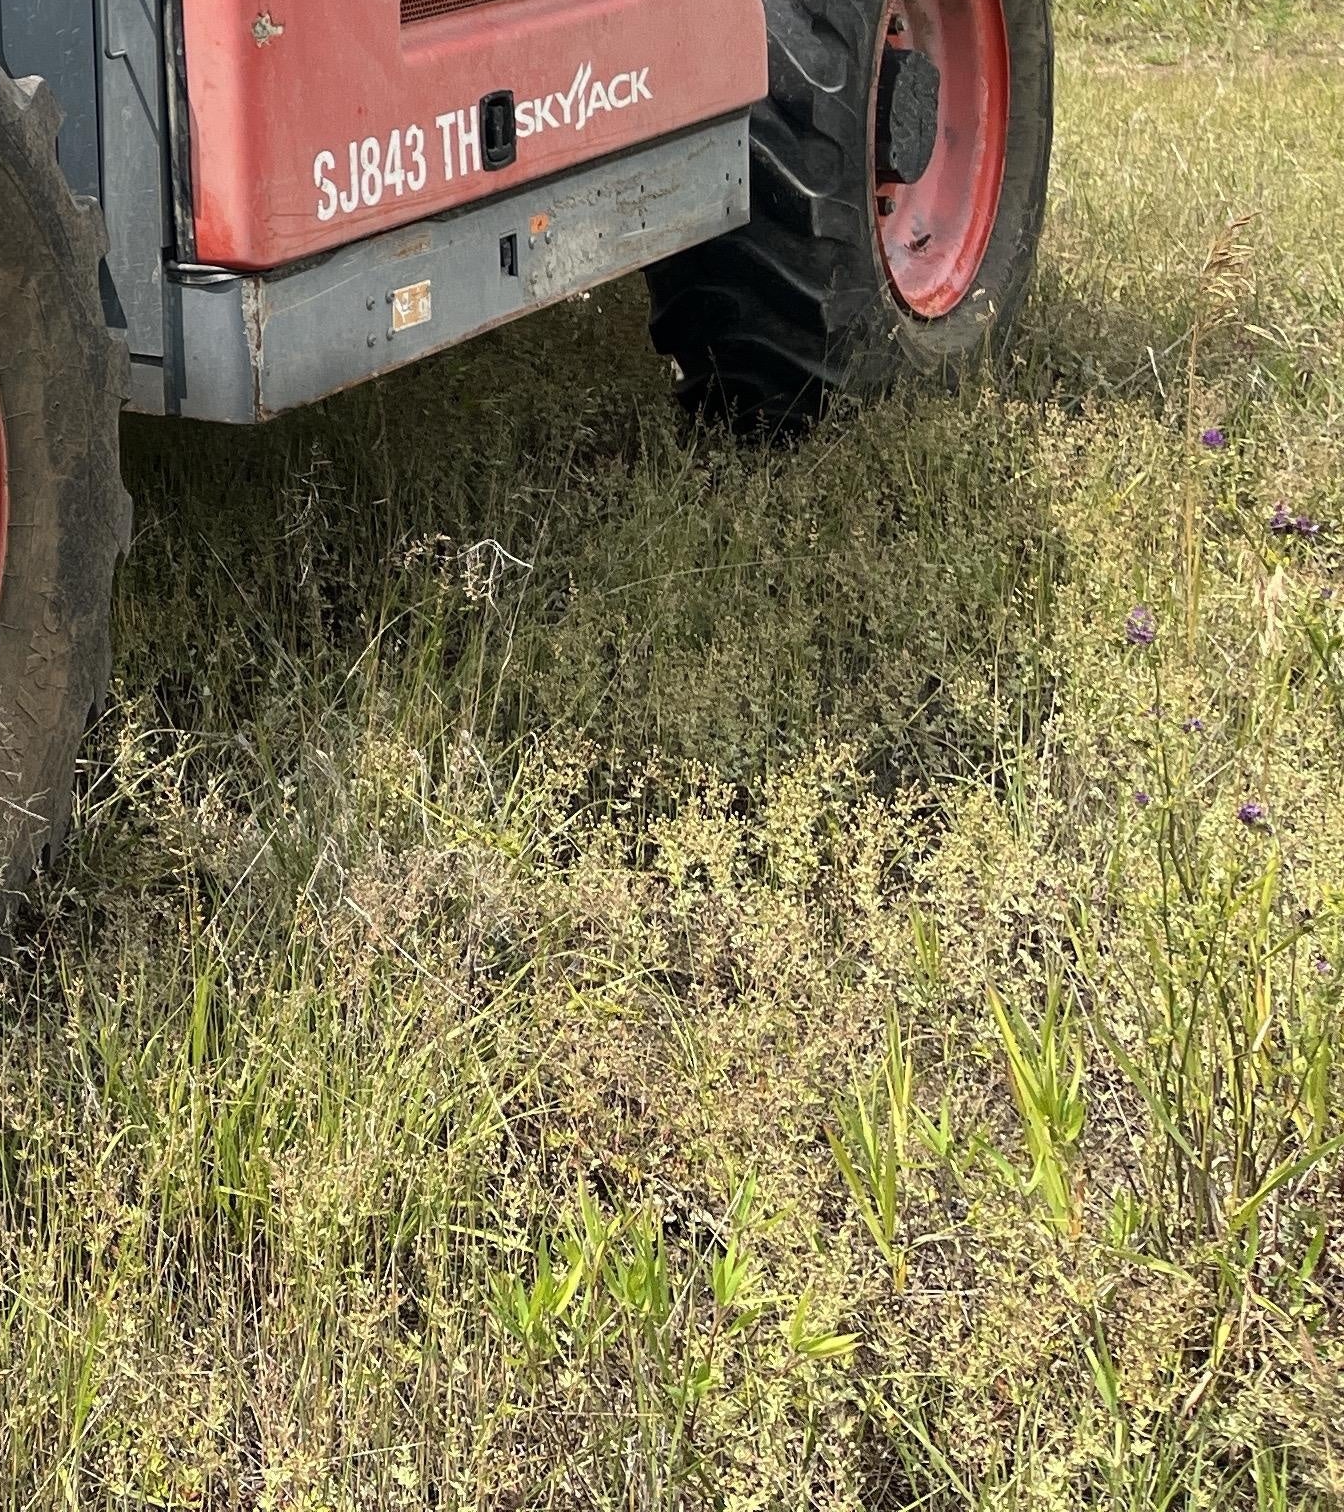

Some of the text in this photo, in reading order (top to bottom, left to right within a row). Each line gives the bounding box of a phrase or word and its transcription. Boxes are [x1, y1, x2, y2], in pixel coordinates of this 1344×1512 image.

[514, 60, 653, 138] SKYJACK
[314, 105, 481, 221] SJ843 TH
